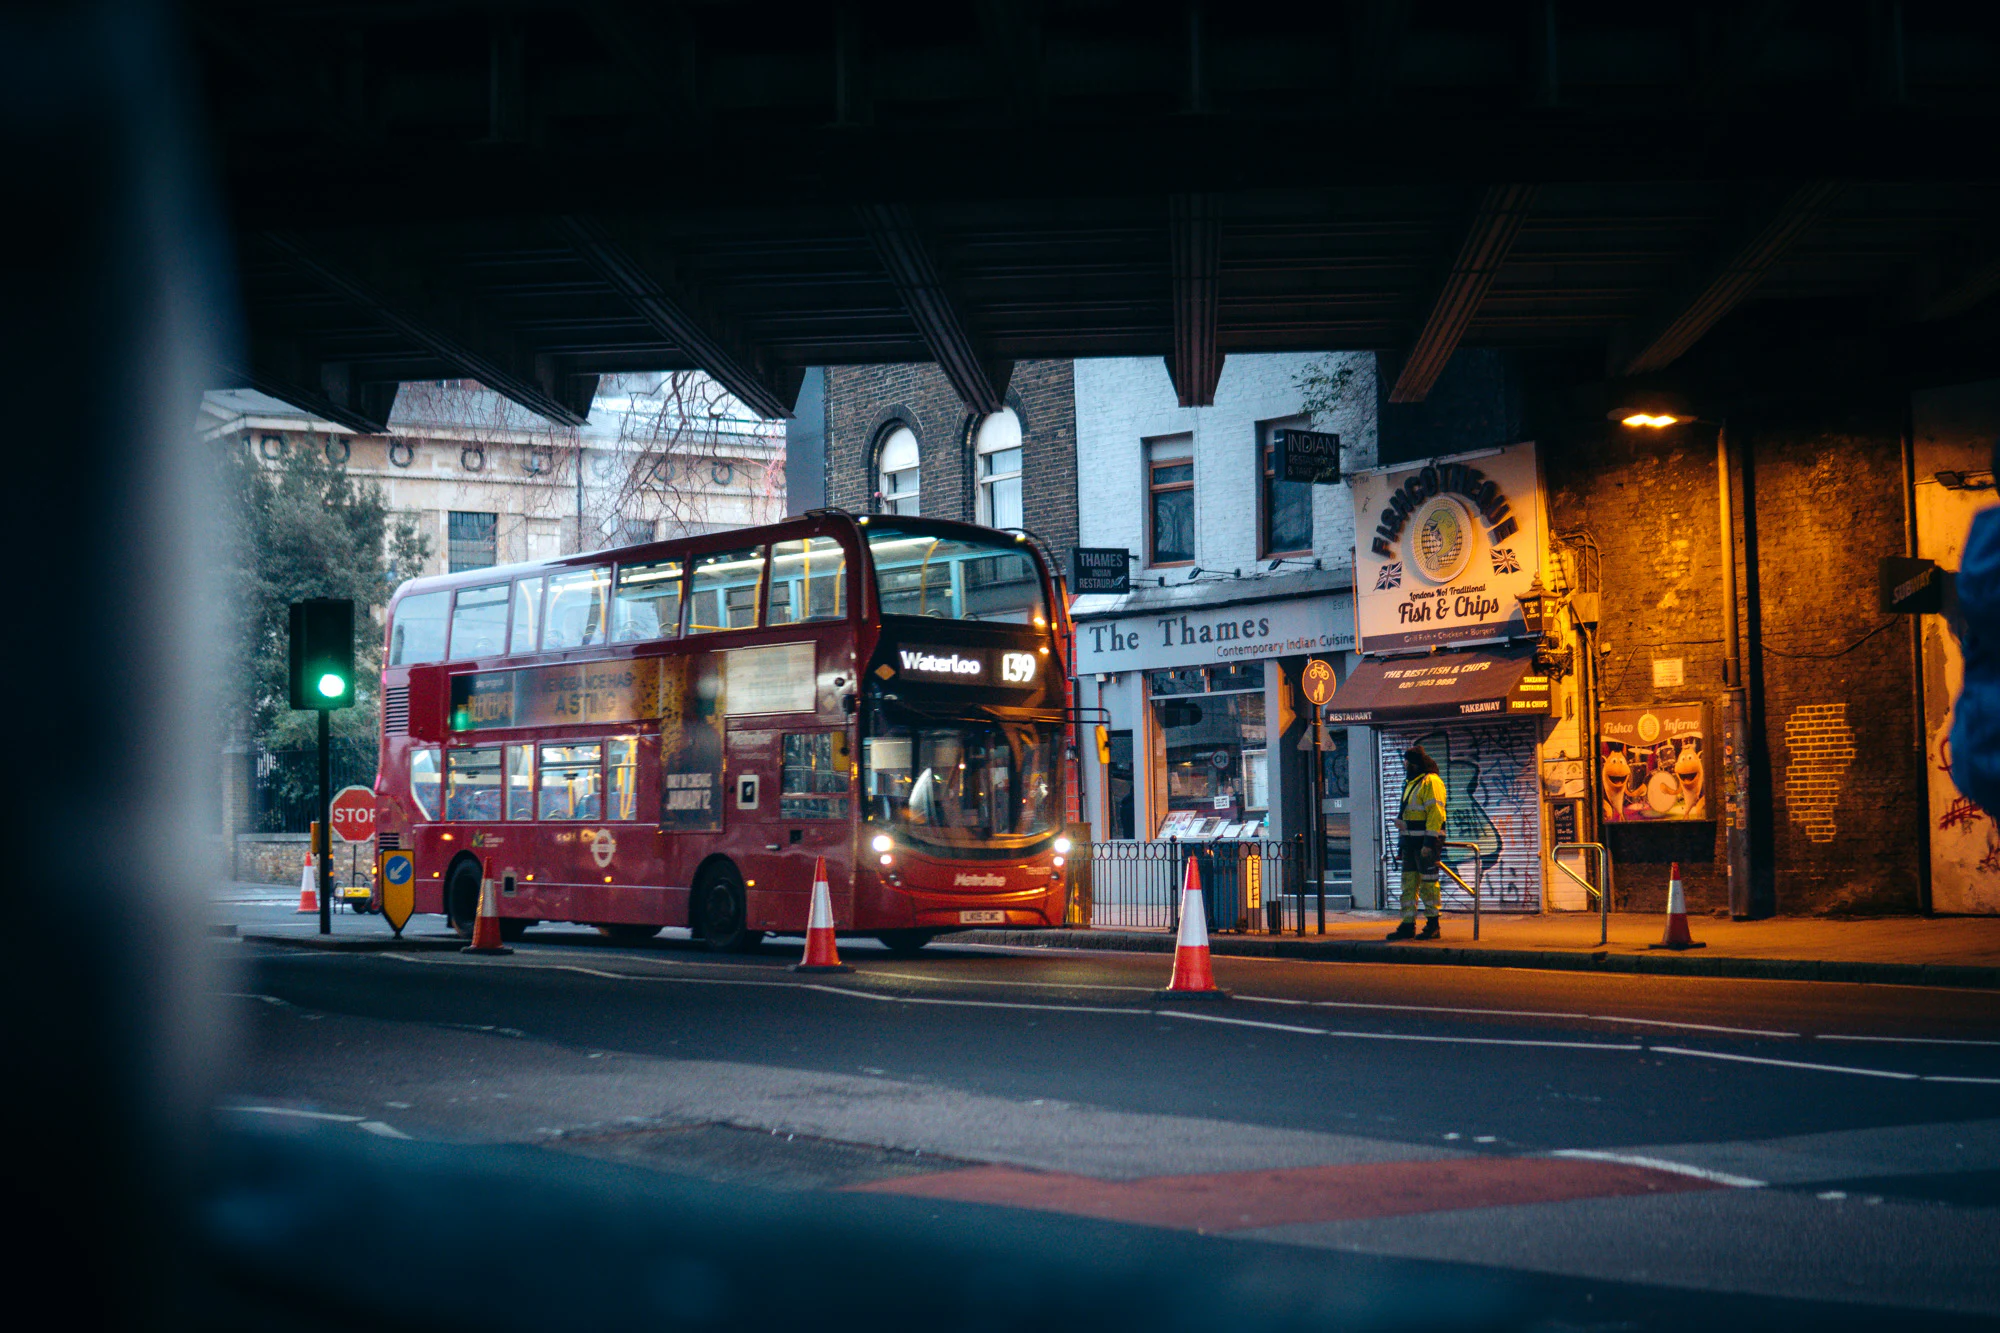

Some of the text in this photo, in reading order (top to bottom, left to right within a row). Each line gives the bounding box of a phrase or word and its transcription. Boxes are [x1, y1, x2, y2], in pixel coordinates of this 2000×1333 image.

[1287, 433, 1336, 456] INDIAN
[1371, 462, 1519, 559] FISHCOTHEQUE
[1079, 553, 1123, 567] THAMES
[1092, 569, 1112, 577] INDIAN
[1409, 590, 1435, 601] Londons
[1449, 583, 1486, 597] Traditional
[1892, 567, 1934, 604] SUBWAY
[1398, 595, 1500, 624] Fish & Chips
[1089, 614, 1270, 653] The Thames
[1403, 627, 1496, 643] Grill Fish Chicken Burgers
[1217, 633, 1355, 658] Contemporary Indian Cuisine
[900, 650, 1036, 682] Waterloo 139
[1383, 661, 1492, 679] THE BEST FISH & CHIPS
[555, 694, 567, 715] A
[1329, 701, 1500, 722] RESTAURANT TAKEAWAY
[1511, 700, 1548, 708] FISH & CHIPS
[1603, 718, 1700, 734] Fishco Inferno
[334, 807, 376, 823] STOP
[953, 872, 1006, 887] Metroline
